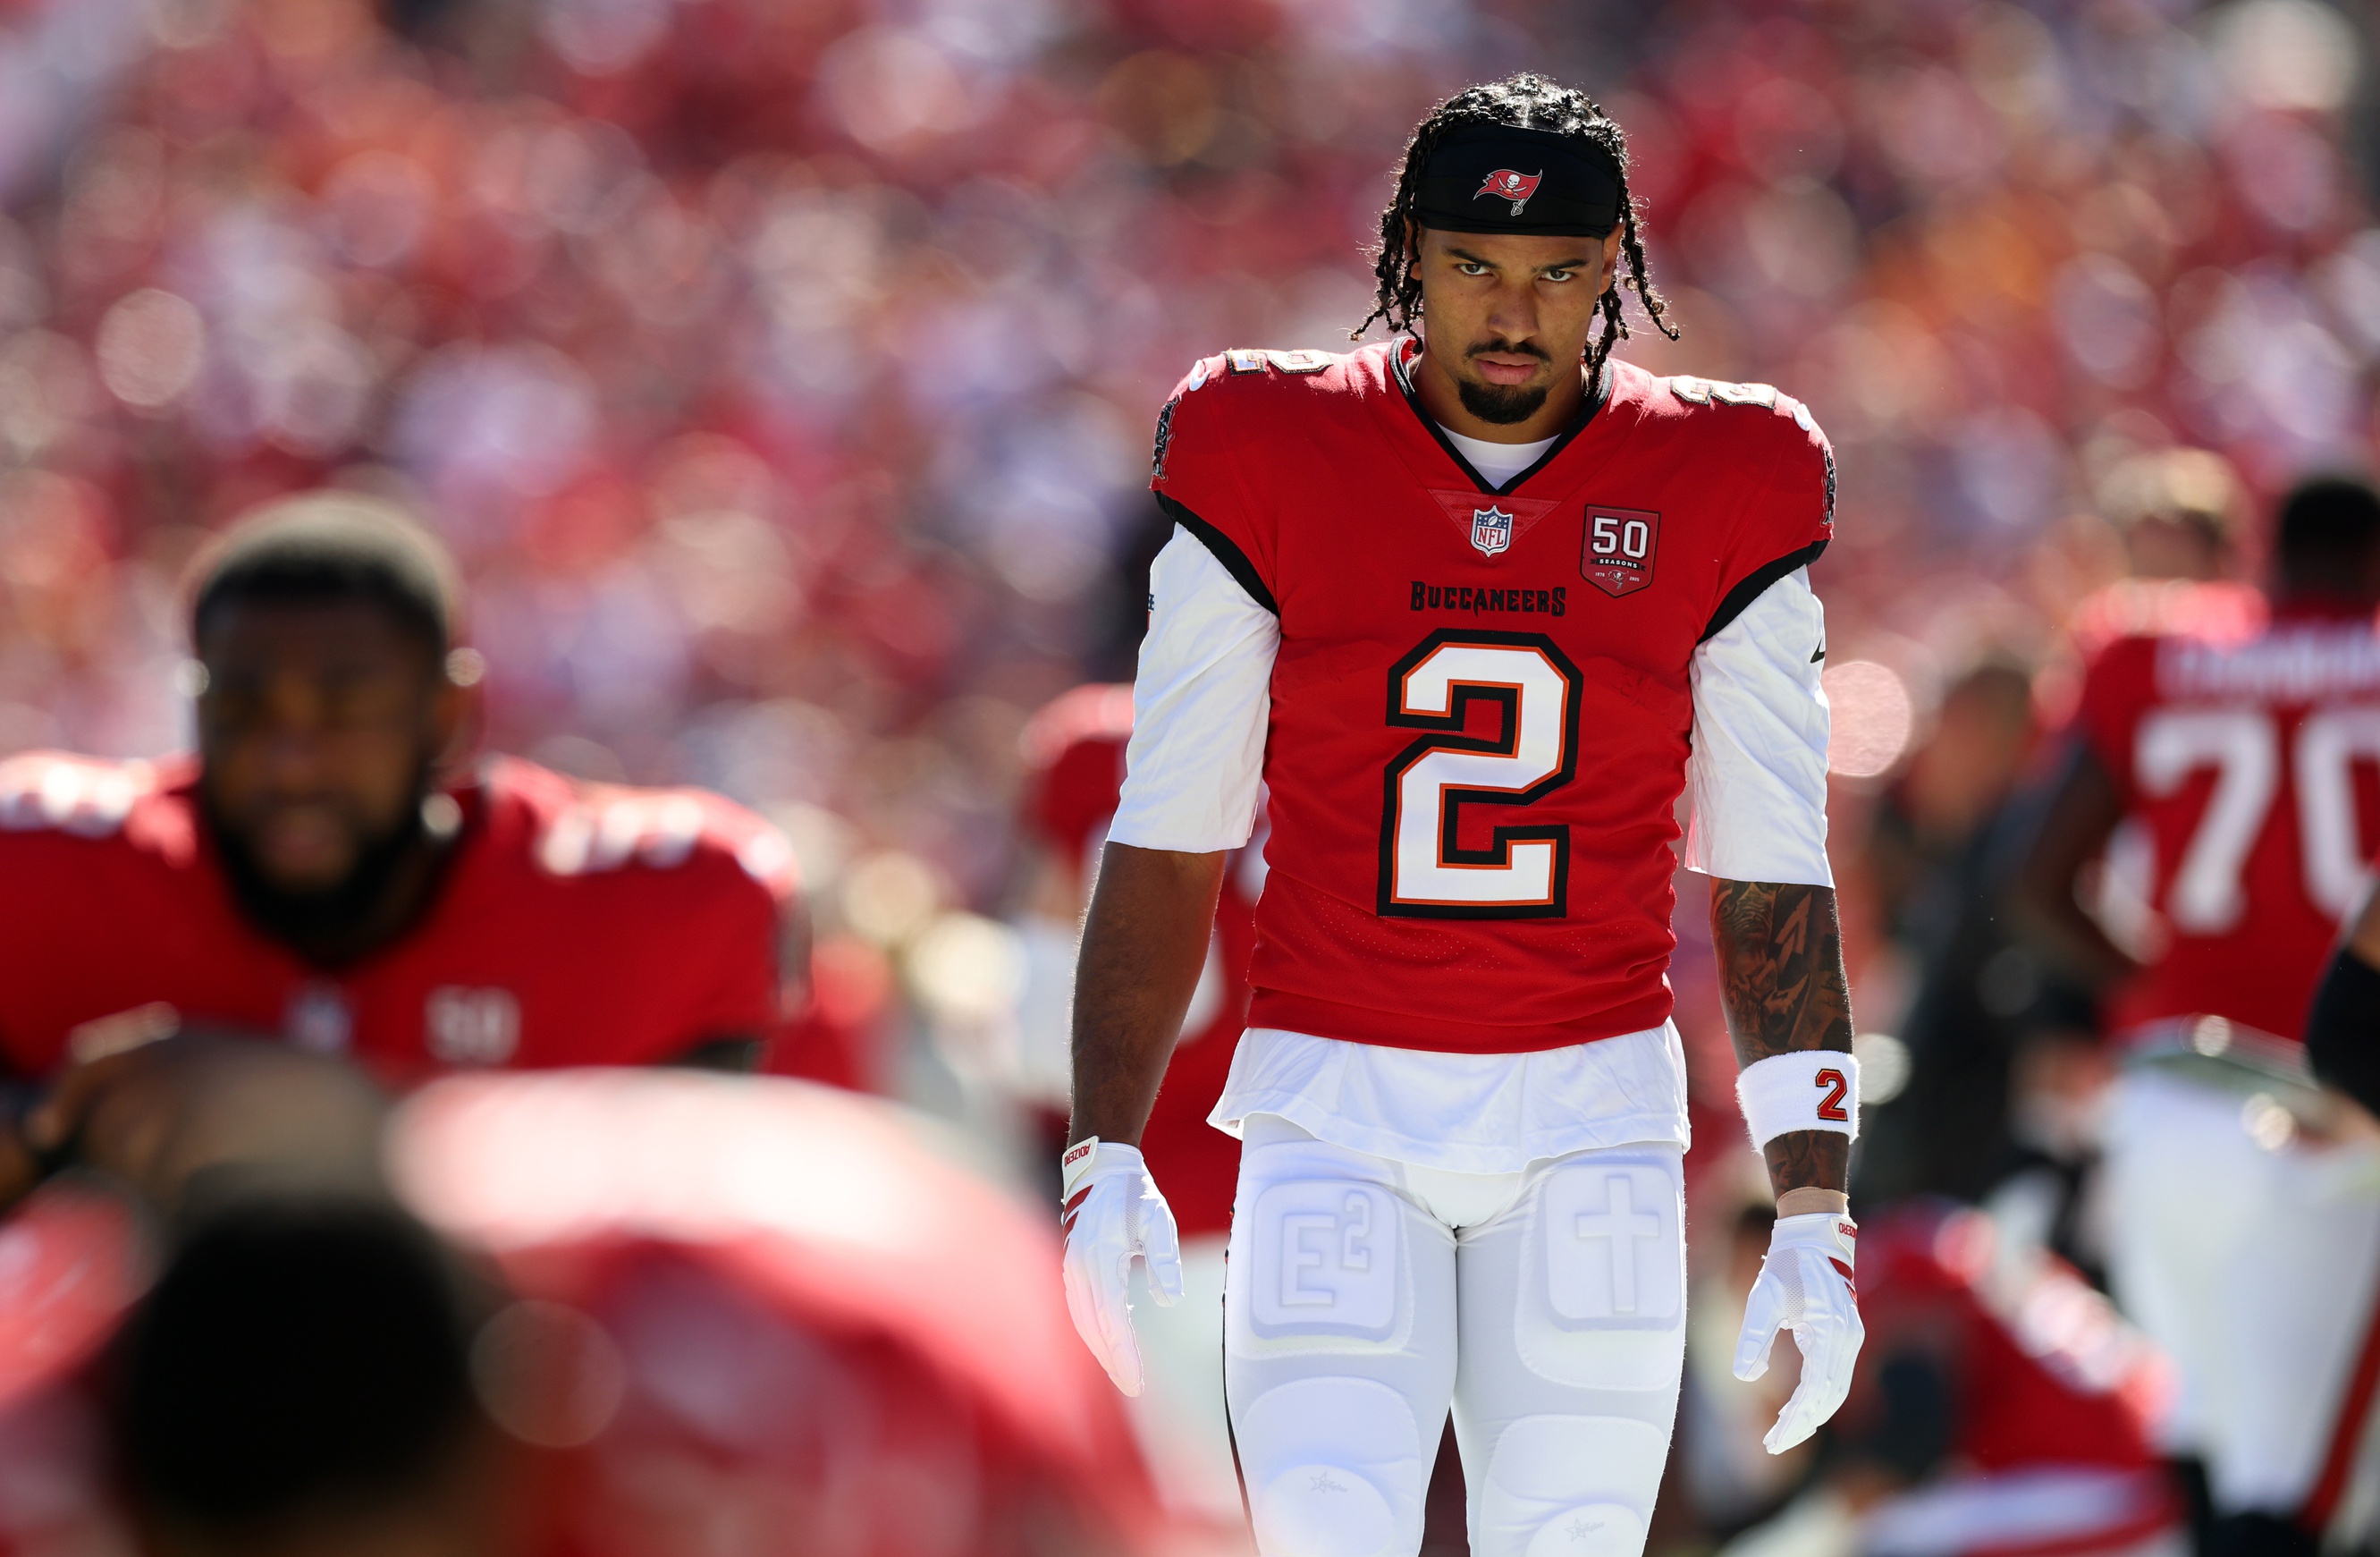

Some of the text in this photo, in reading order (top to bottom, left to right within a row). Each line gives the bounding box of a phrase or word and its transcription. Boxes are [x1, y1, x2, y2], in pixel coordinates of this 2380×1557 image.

[1476, 527, 1505, 546] NFL
[1591, 515, 1650, 560] 50
[1599, 558, 1638, 569] SEASONS
[1377, 629, 1584, 918] 2
[1815, 1069, 1848, 1121] 2
